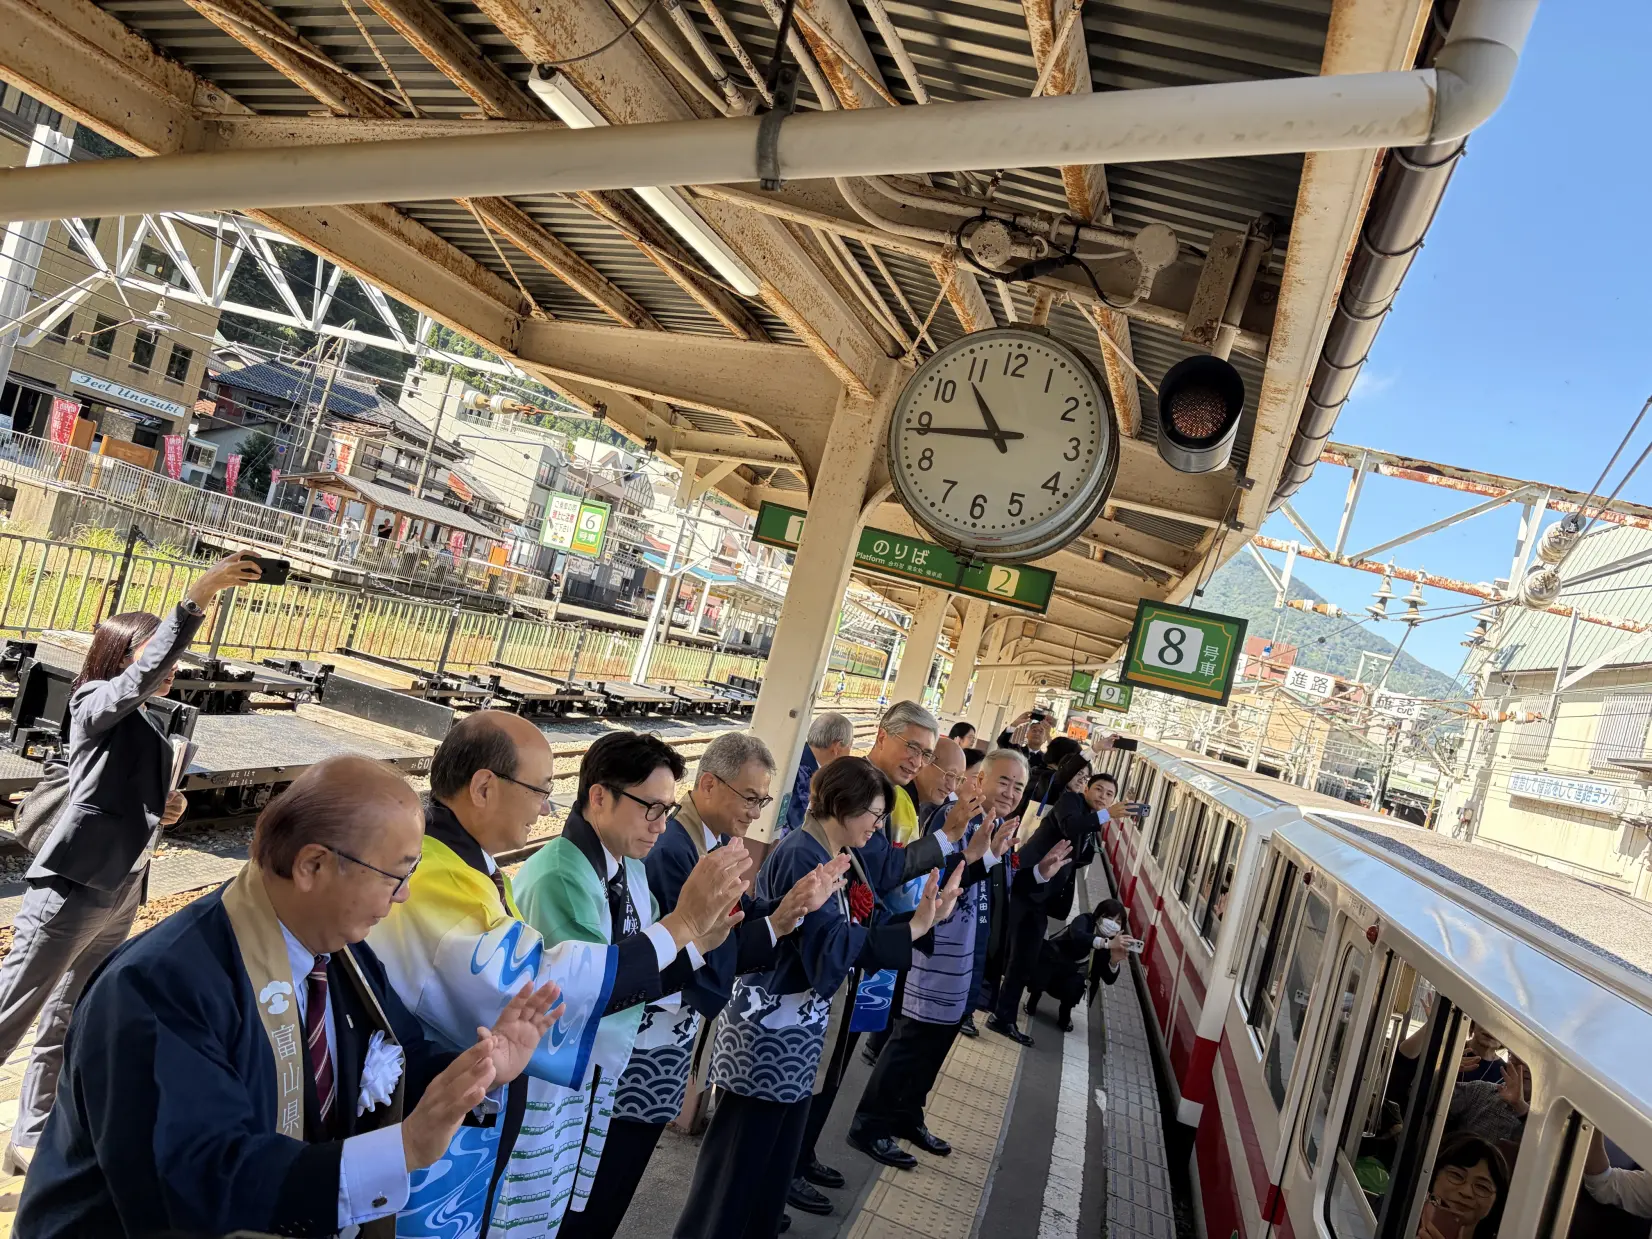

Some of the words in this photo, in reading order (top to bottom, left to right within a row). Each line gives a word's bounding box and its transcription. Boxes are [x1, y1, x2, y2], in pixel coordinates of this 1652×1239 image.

[968, 357, 988, 382] 11
[1003, 352, 1029, 378] 12
[934, 378, 956, 403] 10
[1043, 368, 1054, 393] 1
[76, 374, 111, 392] Feel
[117, 388, 180, 414] Unazuki
[1060, 397, 1080, 422] 2
[917, 410, 933, 436] 9
[917, 448, 934, 471] 8
[1063, 437, 1081, 462] 3
[941, 479, 959, 504] 7
[1041, 471, 1061, 496] 4
[970, 494, 987, 520] 6
[1007, 492, 1026, 517] 5
[585, 514, 597, 530] 6
[855, 551, 886, 565] Platform
[873, 540, 930, 565] のりば
[993, 569, 1012, 594] 2
[1157, 627, 1187, 666] 8
[1199, 644, 1220, 677] 号車
[1105, 687, 1116, 701] 9
[1290, 670, 1329, 694] 進路
[1375, 693, 1416, 717] 確認
[271, 1023, 301, 1135] 富山県
